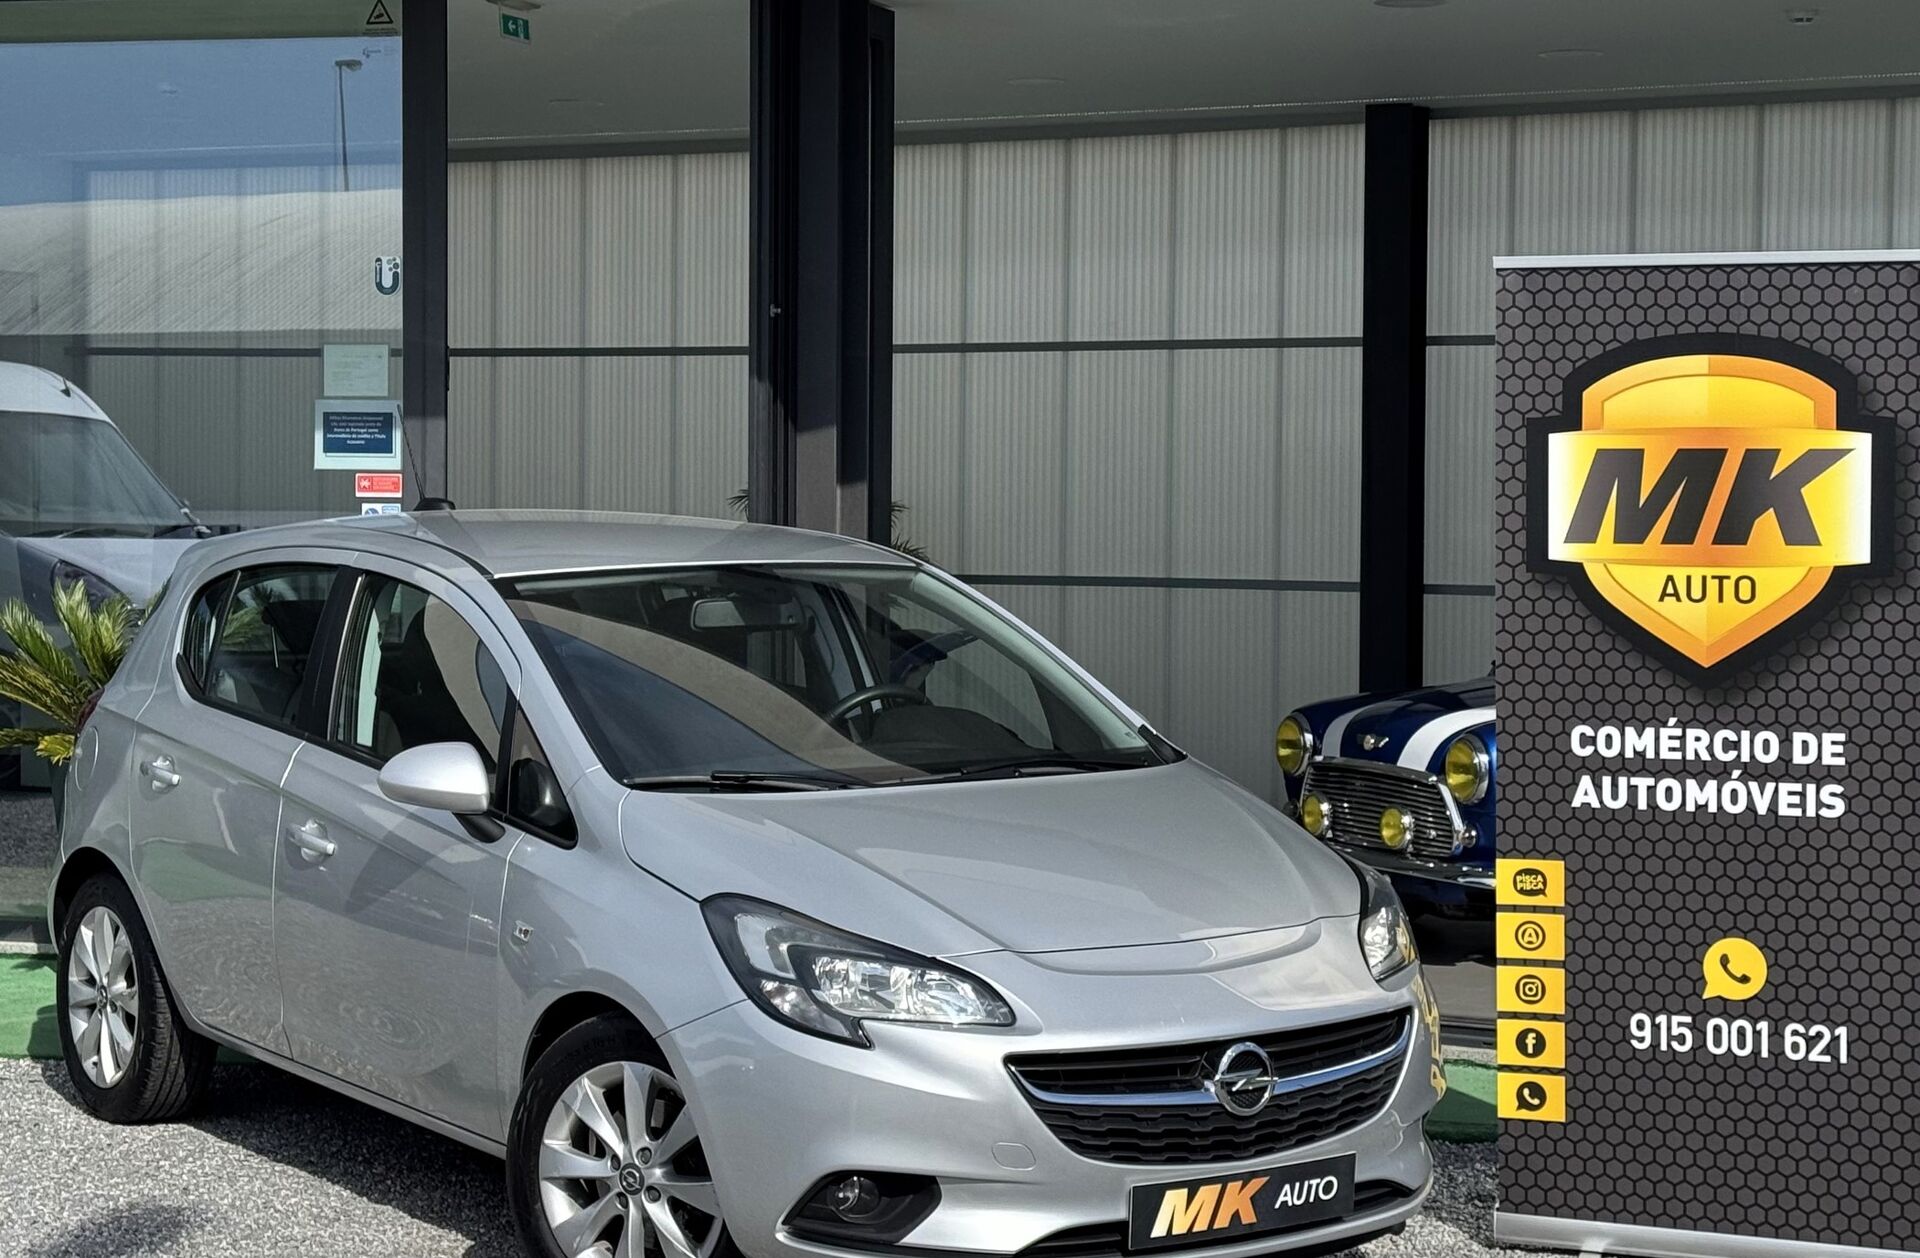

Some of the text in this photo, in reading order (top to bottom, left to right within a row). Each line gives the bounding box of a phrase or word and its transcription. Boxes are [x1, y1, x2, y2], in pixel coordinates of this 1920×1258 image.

[1563, 448, 1856, 546] MK
[1658, 575, 1757, 605] AUTO
[1570, 717, 1846, 766] COMÉRCIO DE
[1571, 770, 1846, 818] AUTOMÓVEIS
[1629, 1012, 1848, 1064] 915 001 621
[1150, 1176, 1338, 1238] MK AUTO
